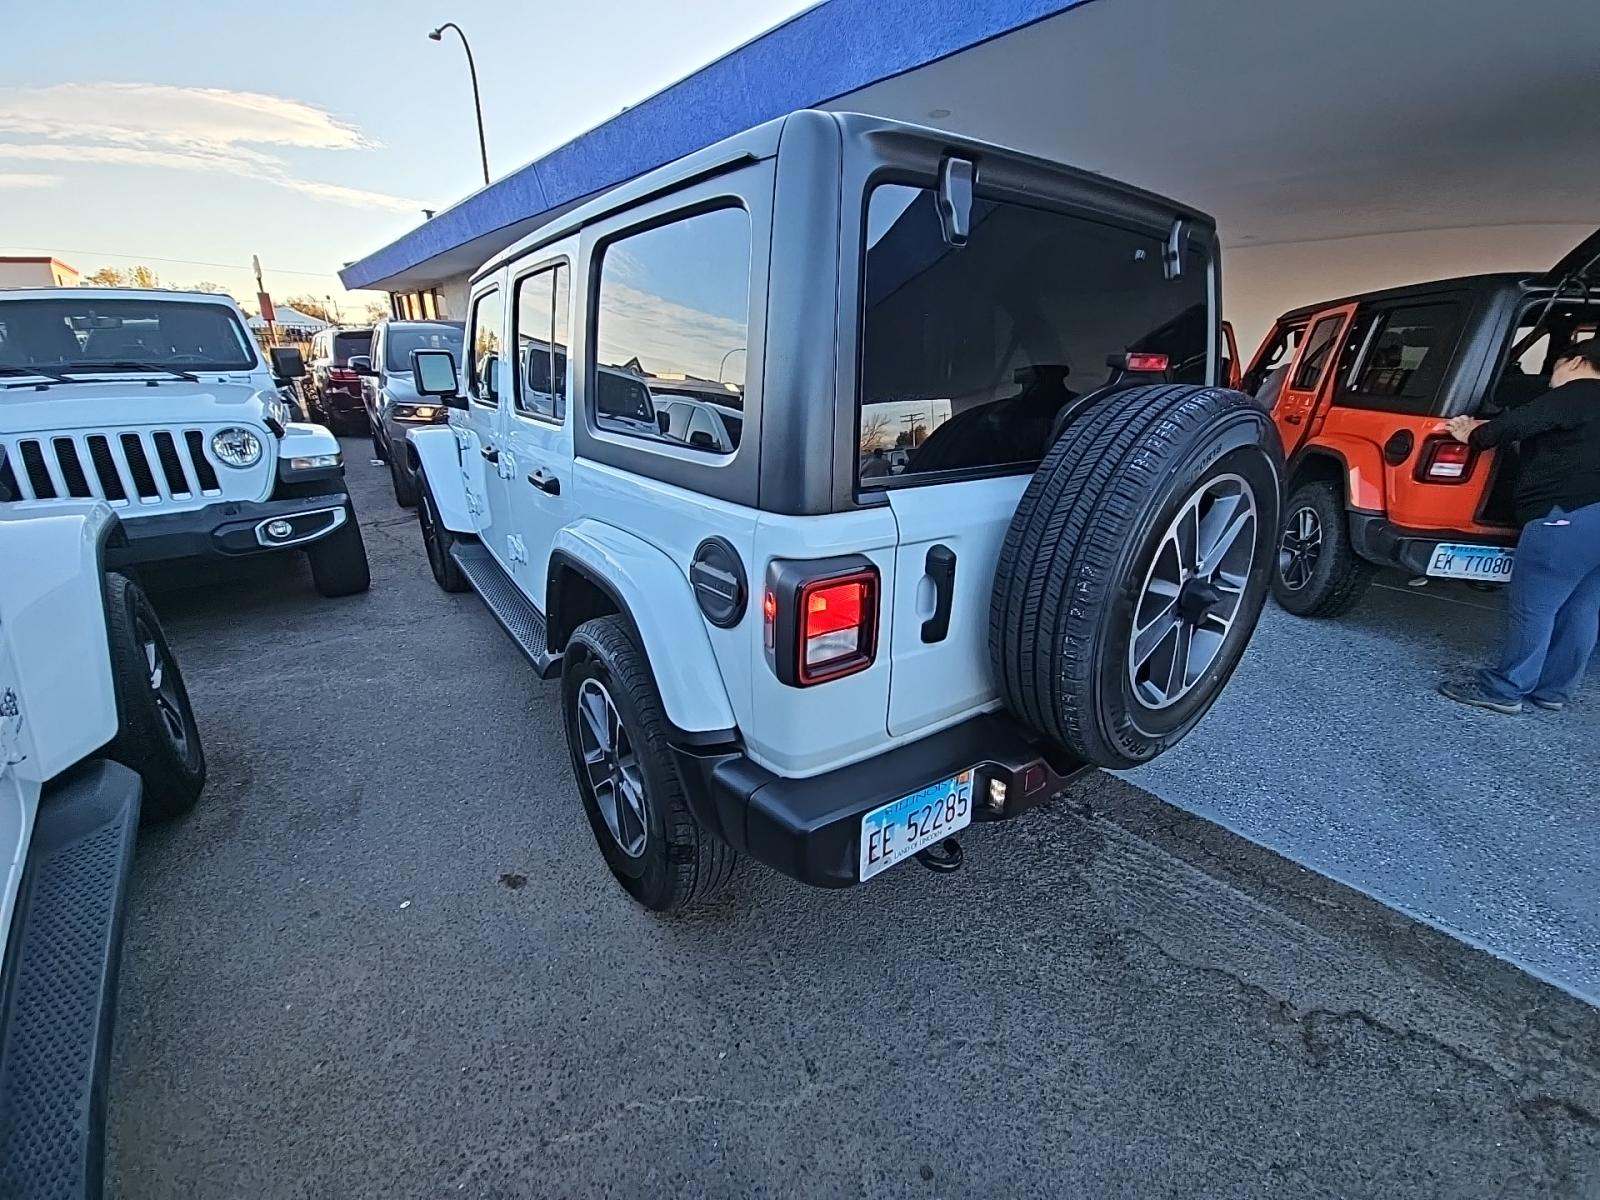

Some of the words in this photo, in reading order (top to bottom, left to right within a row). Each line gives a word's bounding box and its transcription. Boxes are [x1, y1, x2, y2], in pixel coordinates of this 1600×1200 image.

[1433, 553, 1455, 570] EK
[1465, 556, 1513, 575] 77080
[868, 822, 895, 865] EE
[906, 787, 968, 842] 52285
